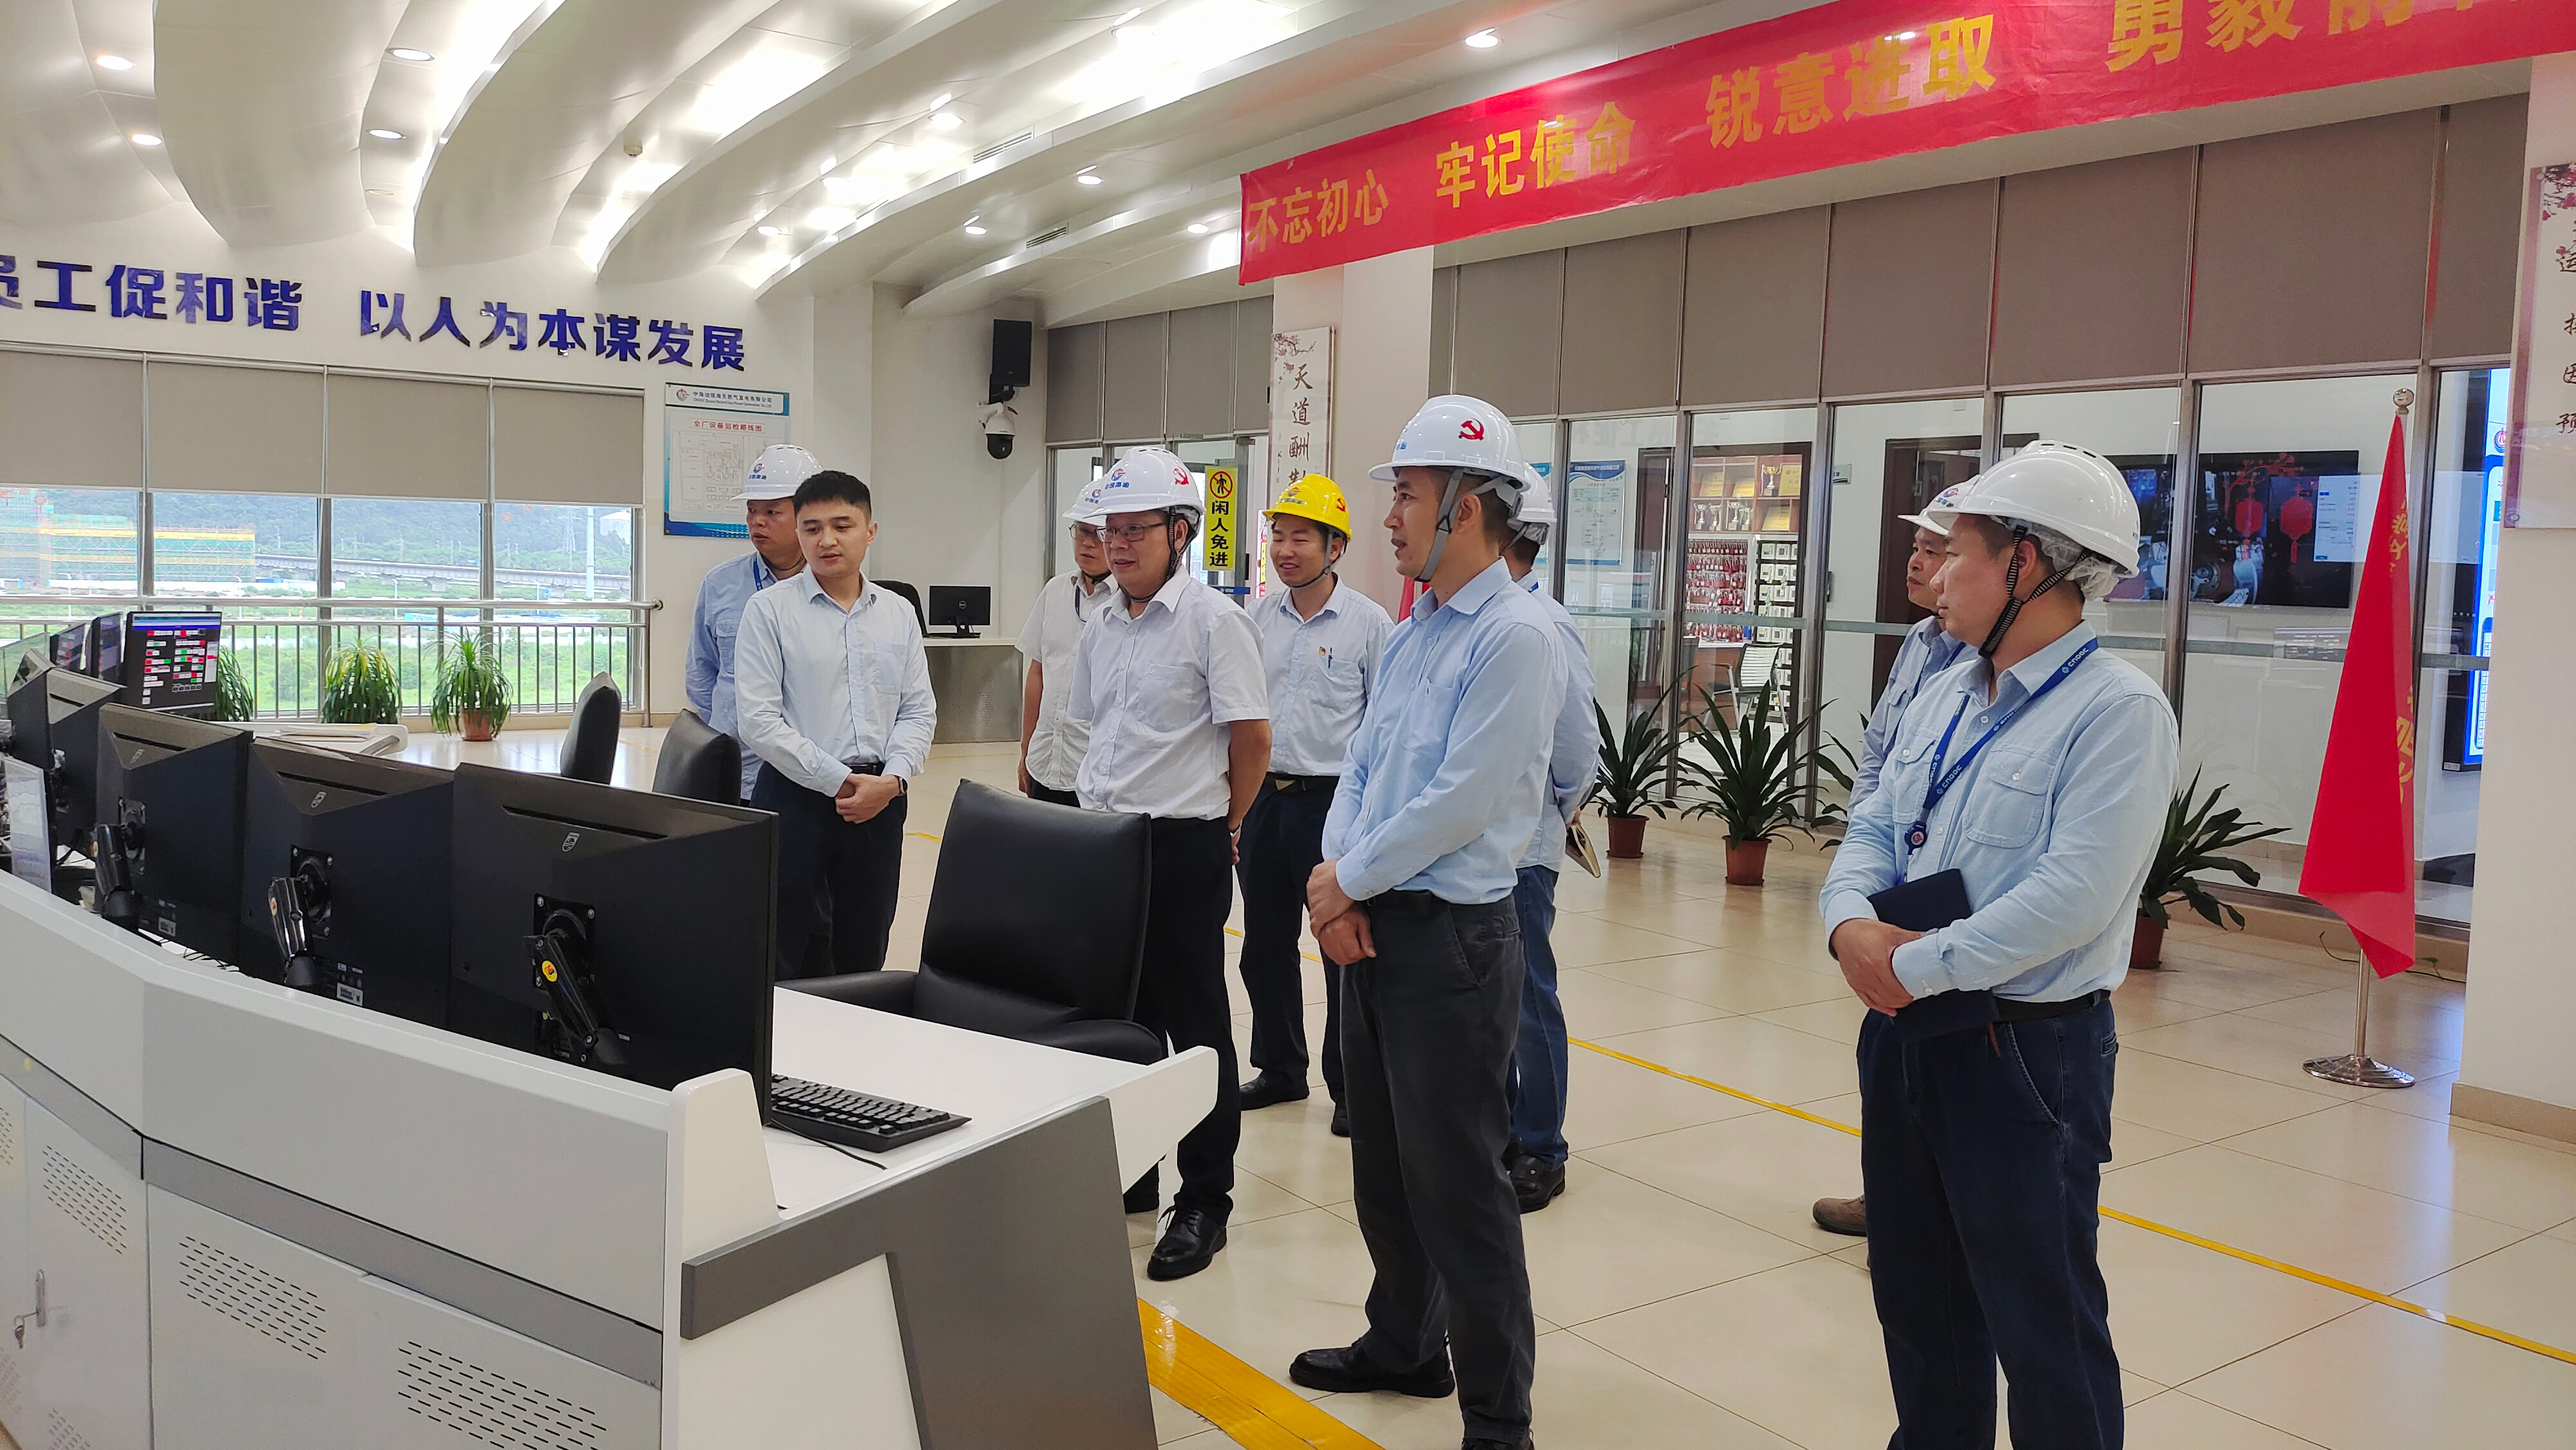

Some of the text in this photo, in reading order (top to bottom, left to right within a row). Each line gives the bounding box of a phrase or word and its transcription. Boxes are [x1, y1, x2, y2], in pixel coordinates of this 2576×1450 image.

[1247, 169, 1389, 252] 不忘初心
[1435, 101, 1636, 209] 牢记使命
[1705, 14, 1996, 149] 锐意进取
[360, 290, 745, 372] 以人为本谋发展
[1209, 500, 1229, 567] 闲人免进
